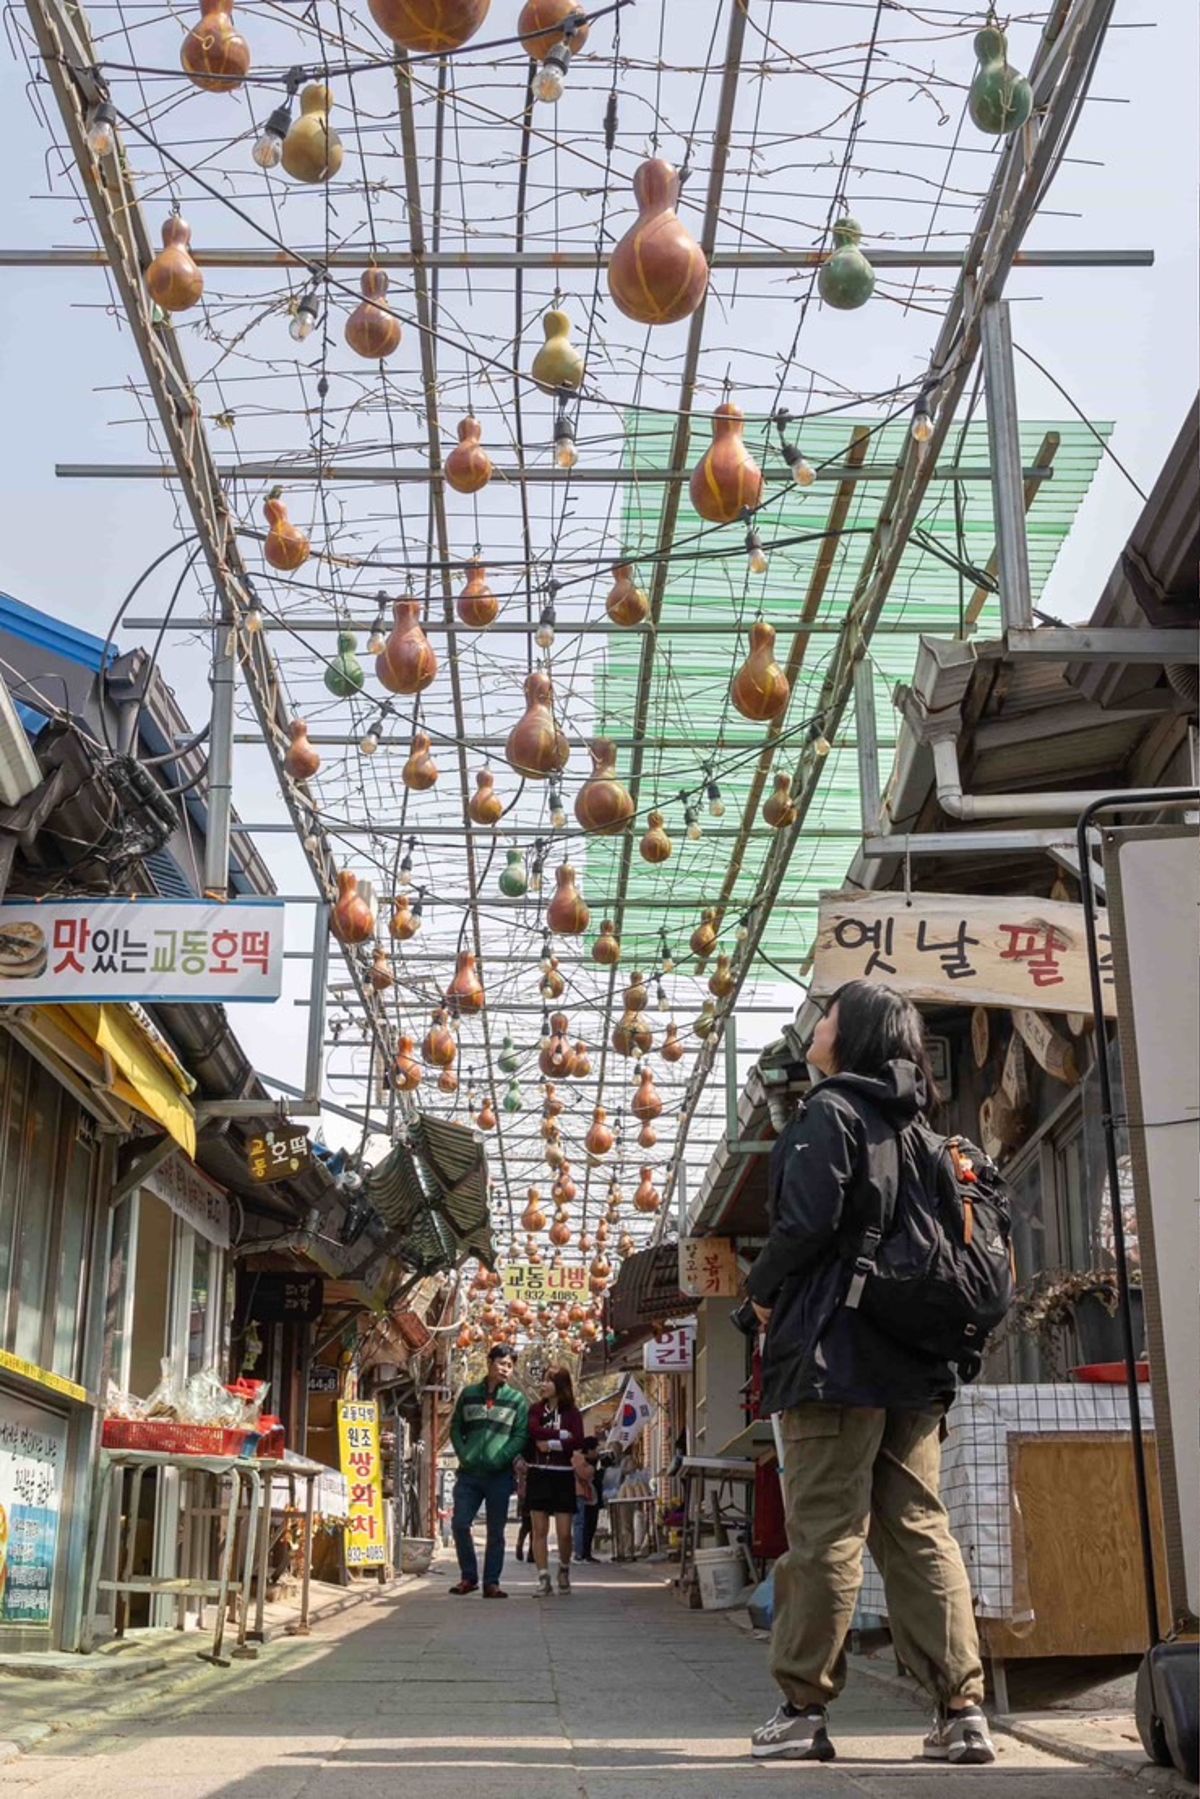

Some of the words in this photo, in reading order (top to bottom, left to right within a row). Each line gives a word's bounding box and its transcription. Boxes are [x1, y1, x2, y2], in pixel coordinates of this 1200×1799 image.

[272, 1137, 308, 1165] 호떡
[347, 1427, 372, 1448] 원조
[349, 1452, 377, 1539] 쌍화차
